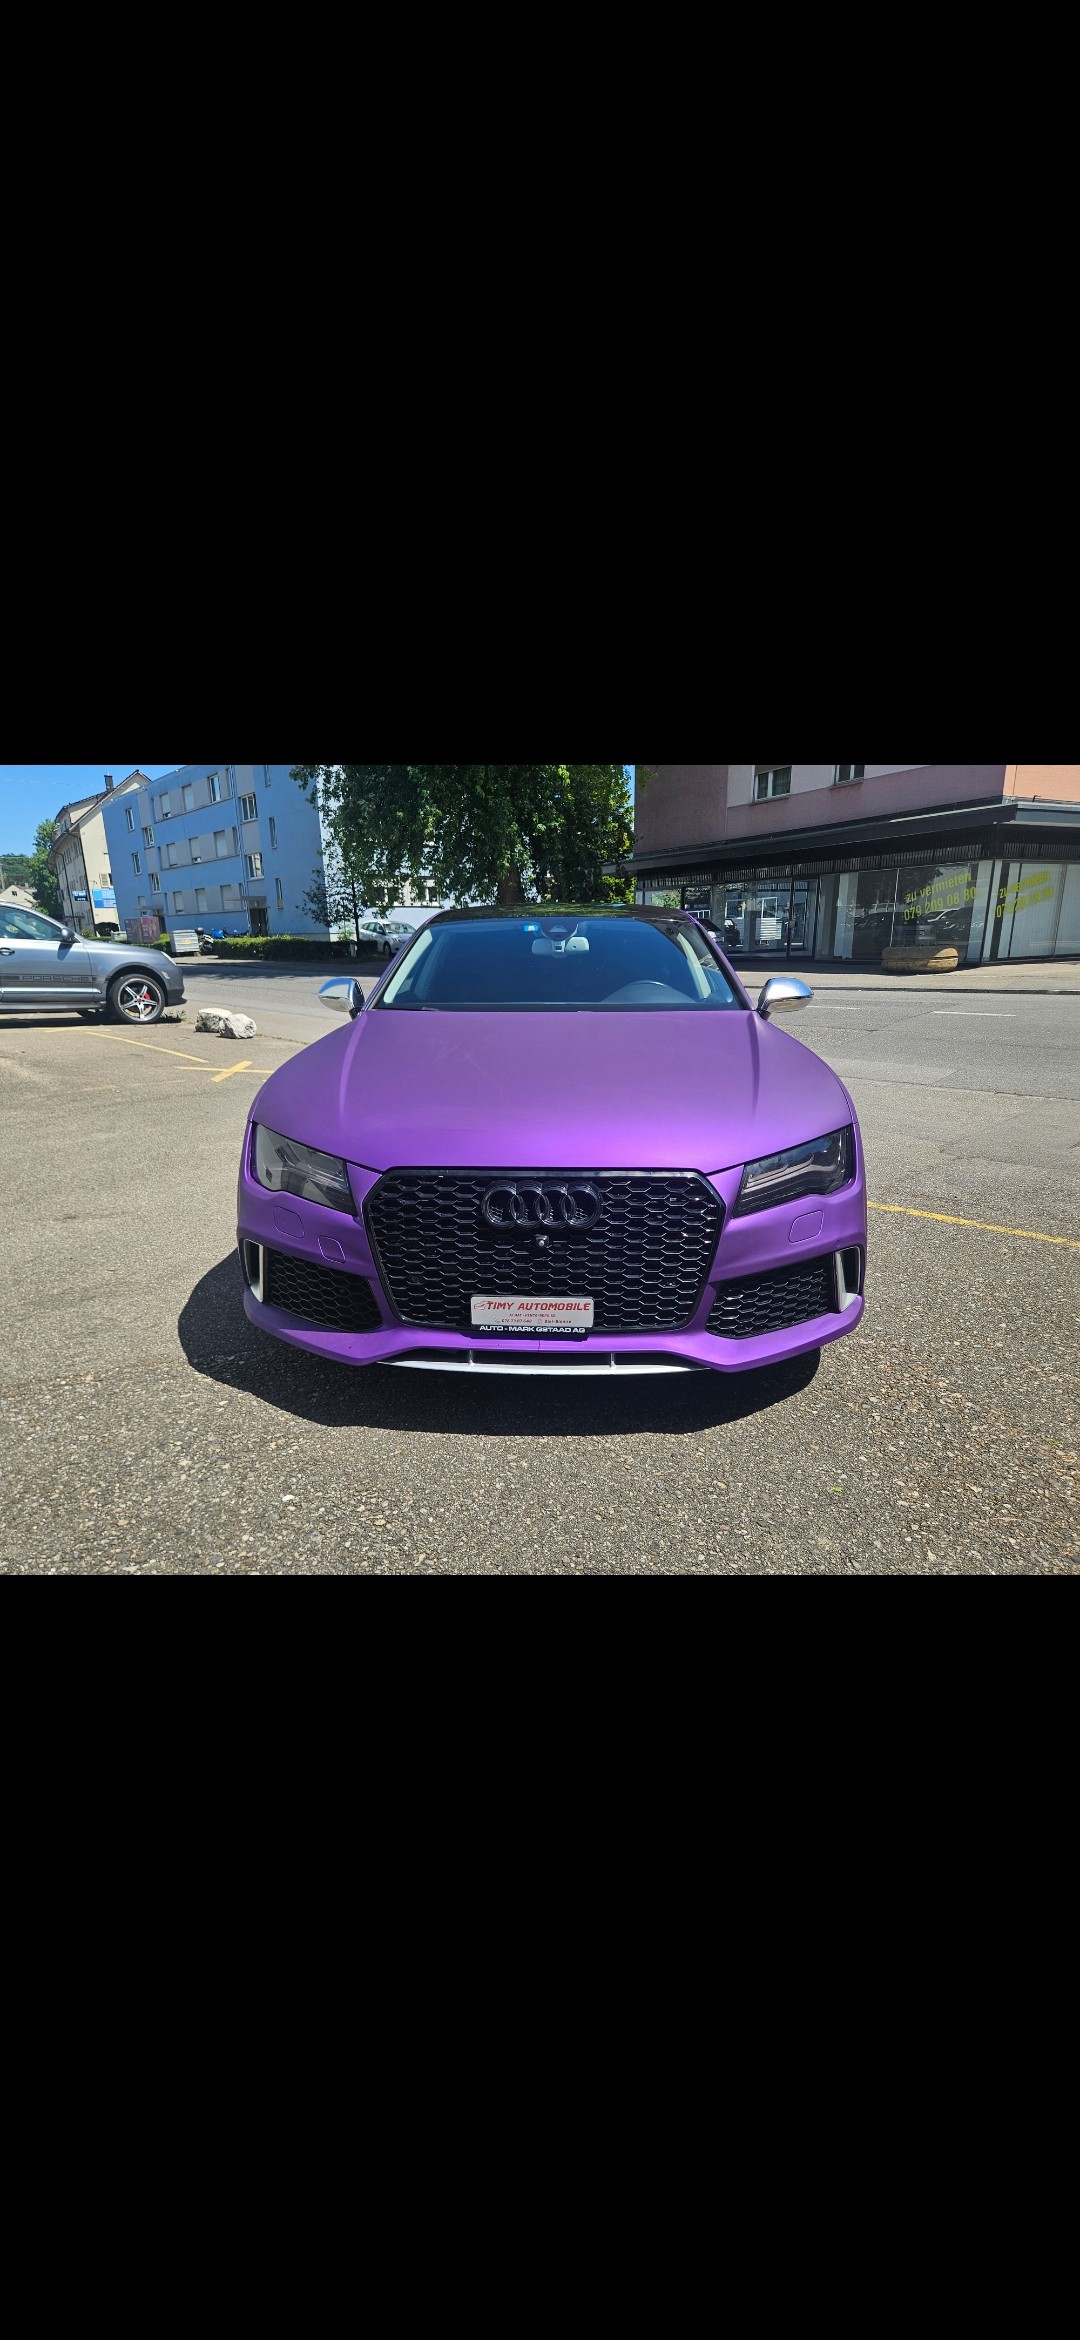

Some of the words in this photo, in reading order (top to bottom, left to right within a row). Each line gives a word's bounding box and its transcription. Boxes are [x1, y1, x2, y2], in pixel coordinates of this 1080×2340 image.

[904, 891, 917, 904] zu
[920, 871, 972, 897] vermieten
[903, 905, 922, 921] 079
[925, 897, 944, 914] 209
[946, 892, 960, 907] 08
[487, 1301, 514, 1310] TIMY
[517, 1302, 591, 1311] AUTOMOBILE
